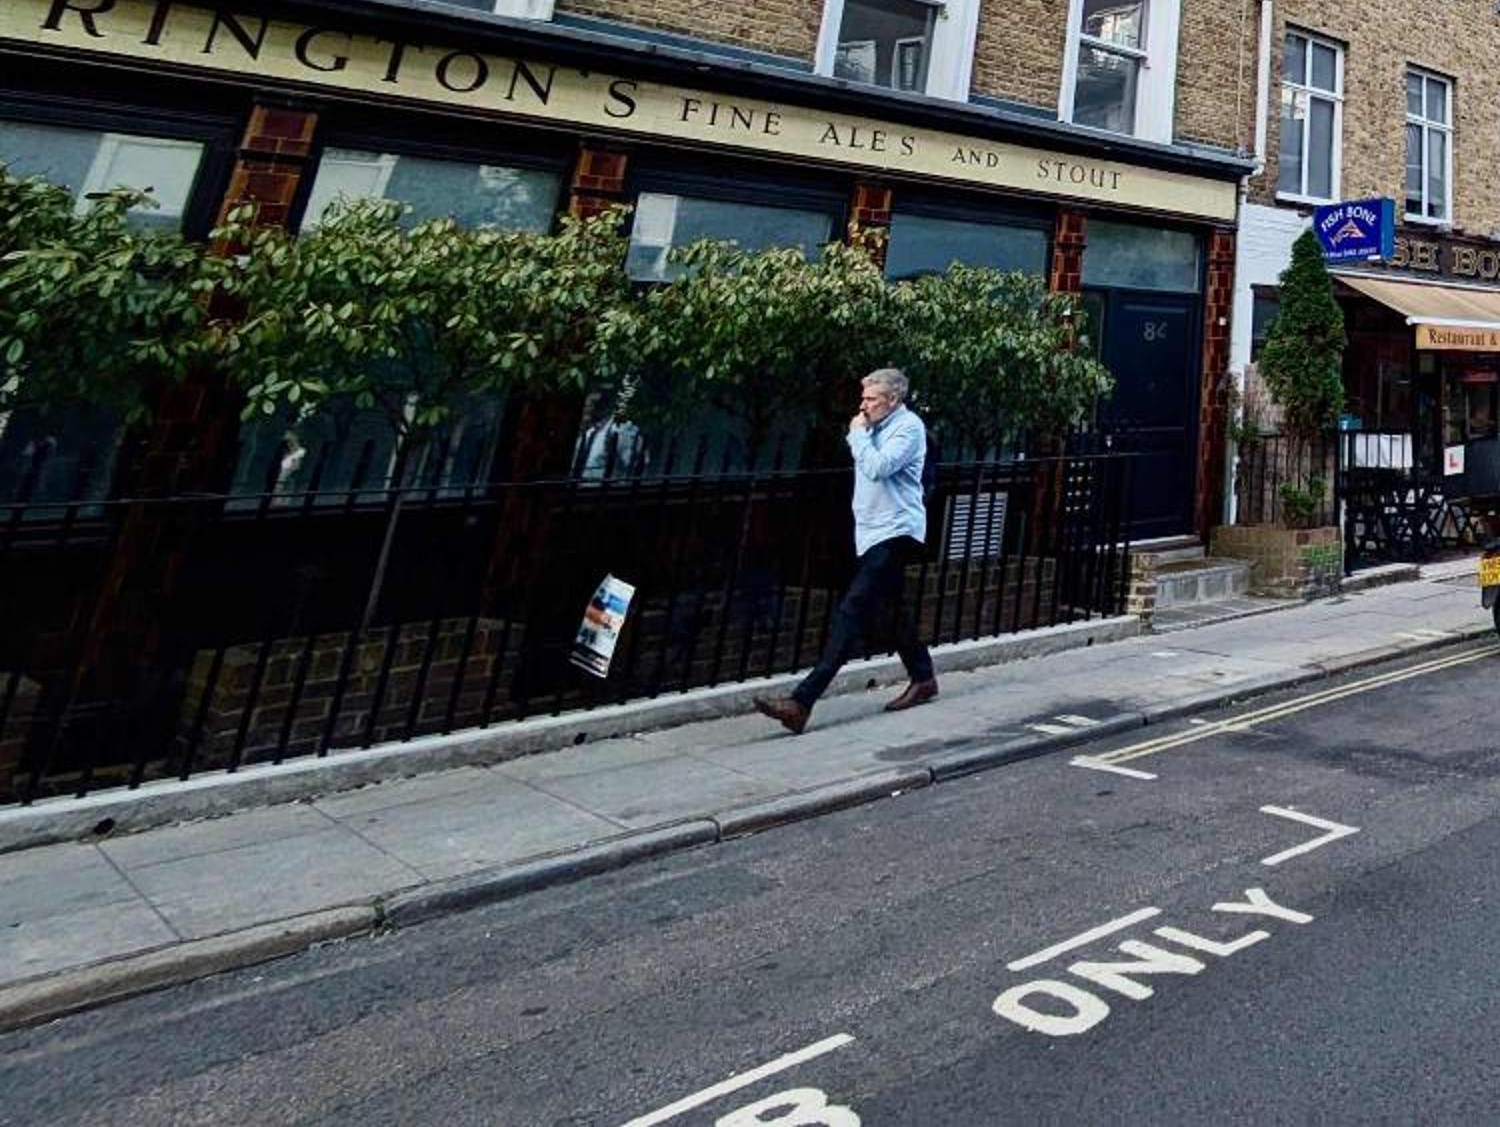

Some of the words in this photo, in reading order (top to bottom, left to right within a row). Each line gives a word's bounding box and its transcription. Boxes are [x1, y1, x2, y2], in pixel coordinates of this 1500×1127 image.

[680, 97, 782, 136] FINE
[818, 121, 917, 157] ALES
[951, 146, 1000, 169] AND
[1036, 158, 1124, 191] STOUT
[1321, 208, 1344, 233] FISH
[1346, 206, 1377, 226] BONE
[1389, 236, 1440, 271] SH
[1428, 329, 1485, 346] Restaurant
[1490, 333, 1498, 346] &
[1449, 453, 1458, 468] L
[992, 887, 1314, 1036] ONLY
